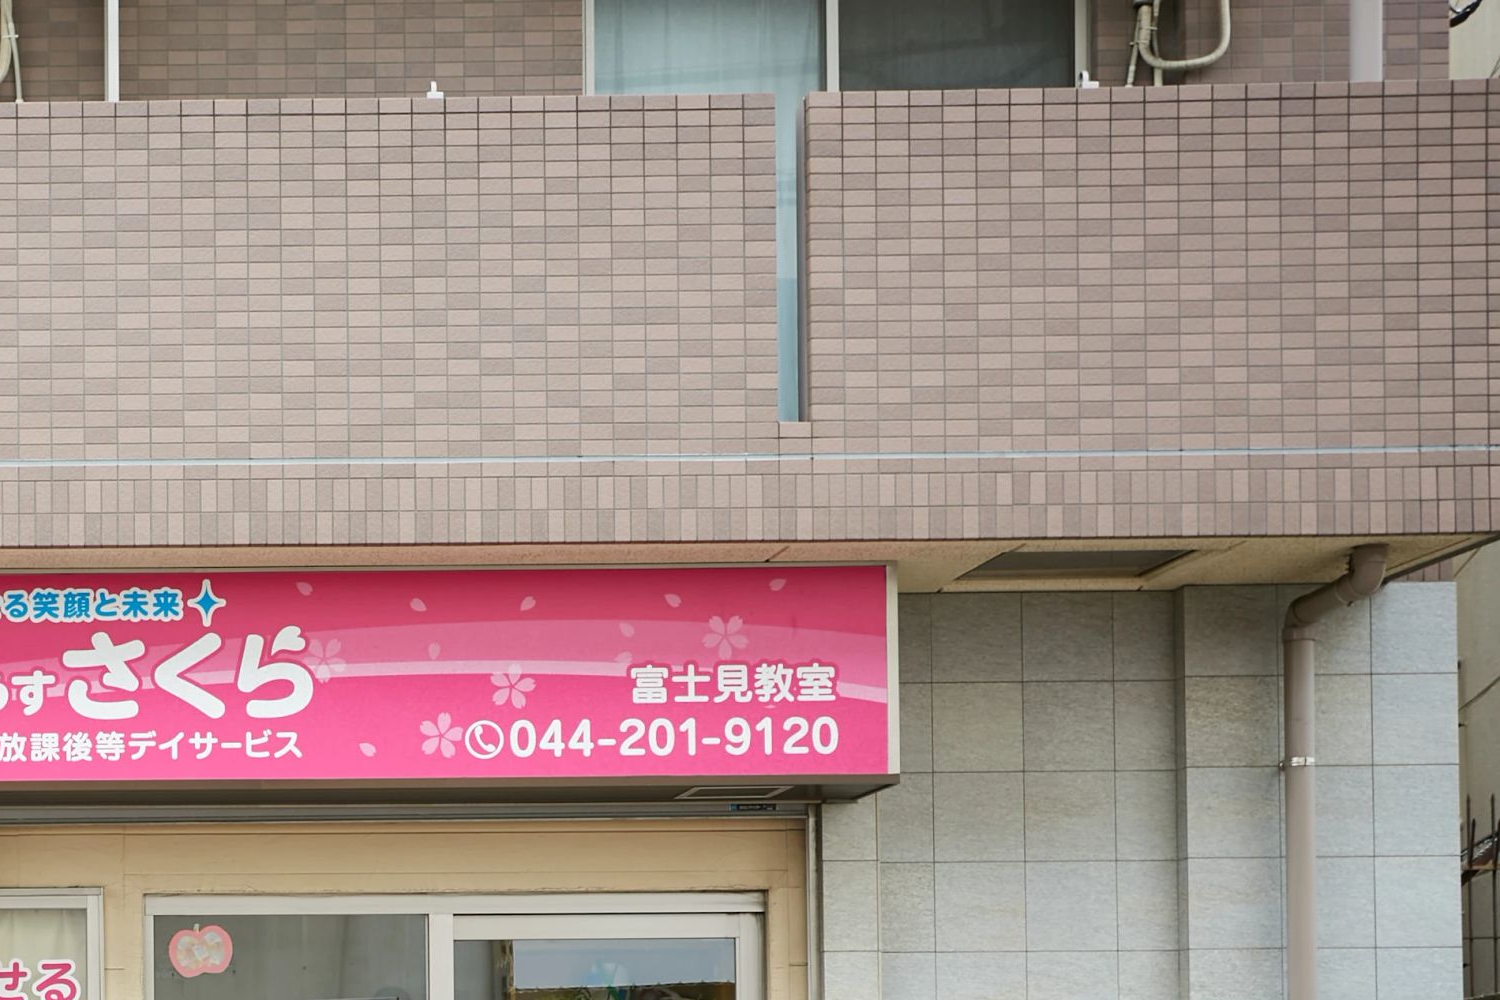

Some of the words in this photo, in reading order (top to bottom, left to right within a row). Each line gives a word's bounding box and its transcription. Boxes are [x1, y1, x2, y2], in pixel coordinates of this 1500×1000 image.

[631, 664, 837, 703] 富士見教室
[510, 716, 839, 758] 044-201-9120
